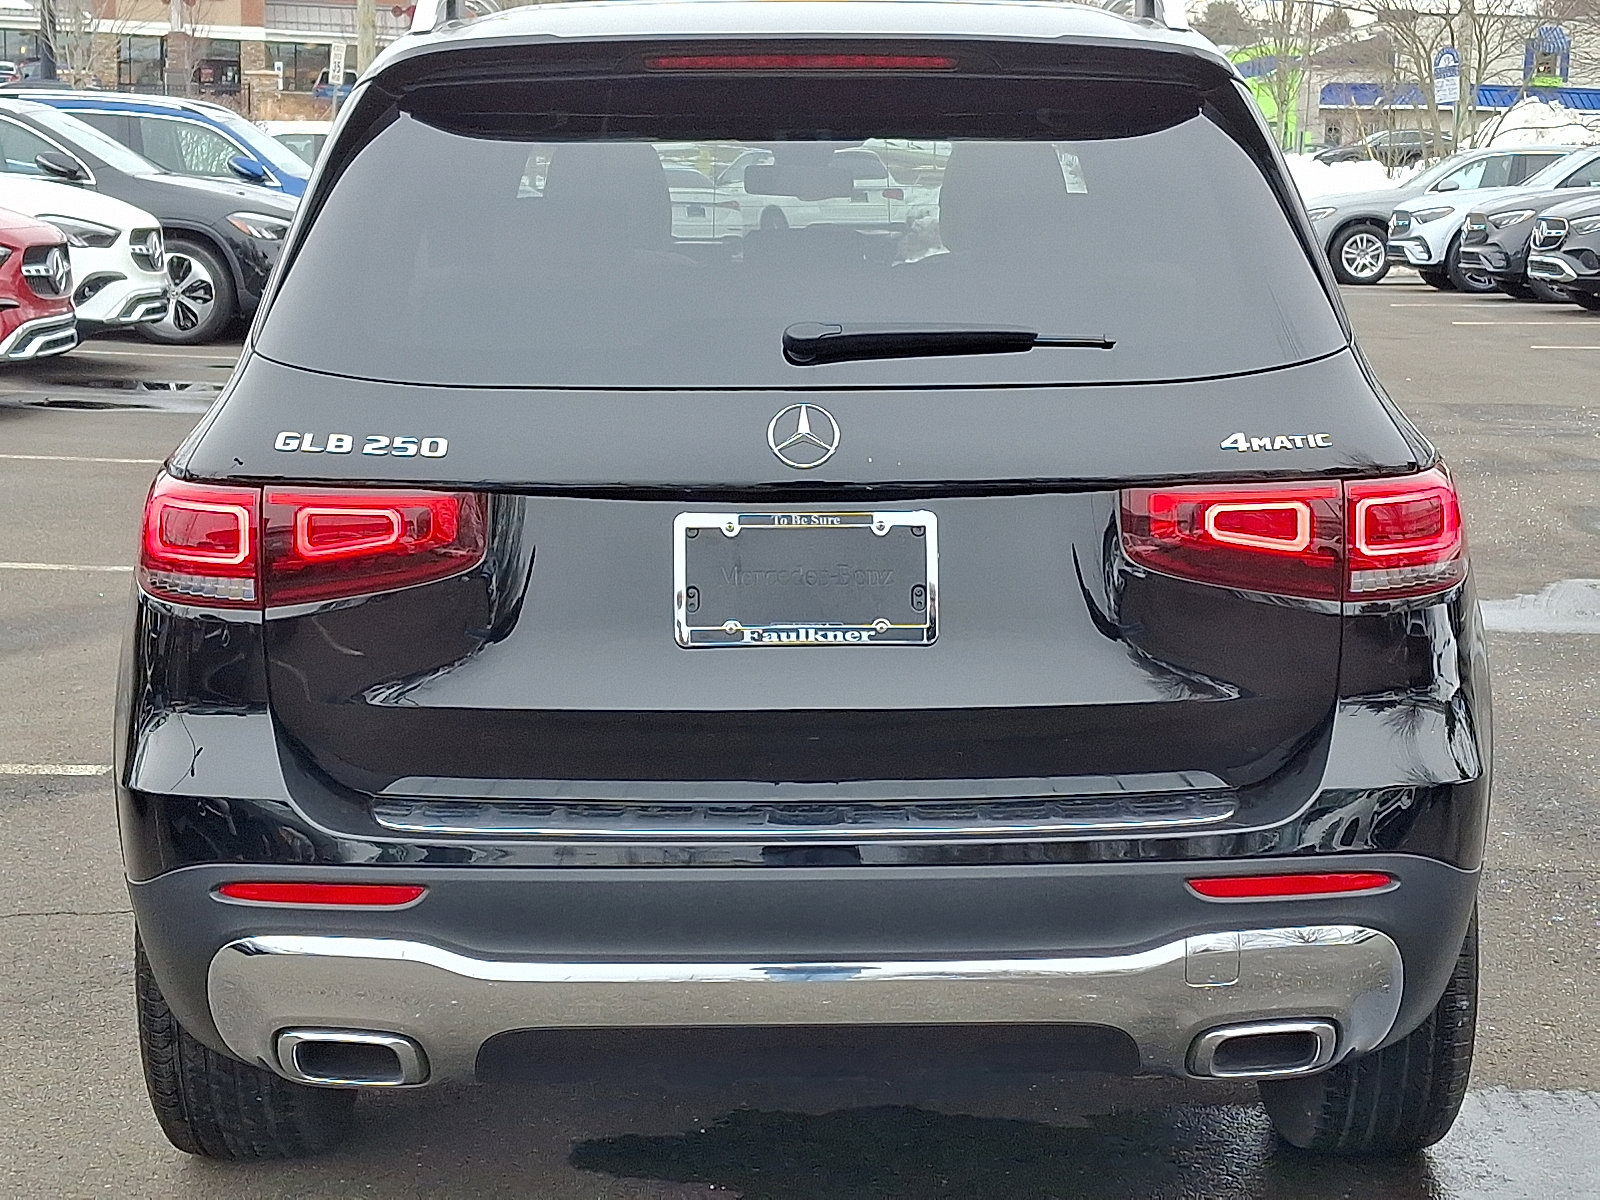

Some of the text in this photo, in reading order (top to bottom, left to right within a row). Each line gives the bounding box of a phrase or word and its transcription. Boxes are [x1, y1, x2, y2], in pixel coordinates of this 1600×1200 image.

[274, 431, 449, 458] GLB 250
[1220, 432, 1333, 452] 4MATIC
[771, 514, 841, 525] To Be Sure
[720, 564, 896, 587] Mercedes-Benz
[741, 628, 876, 643] Faulkner
